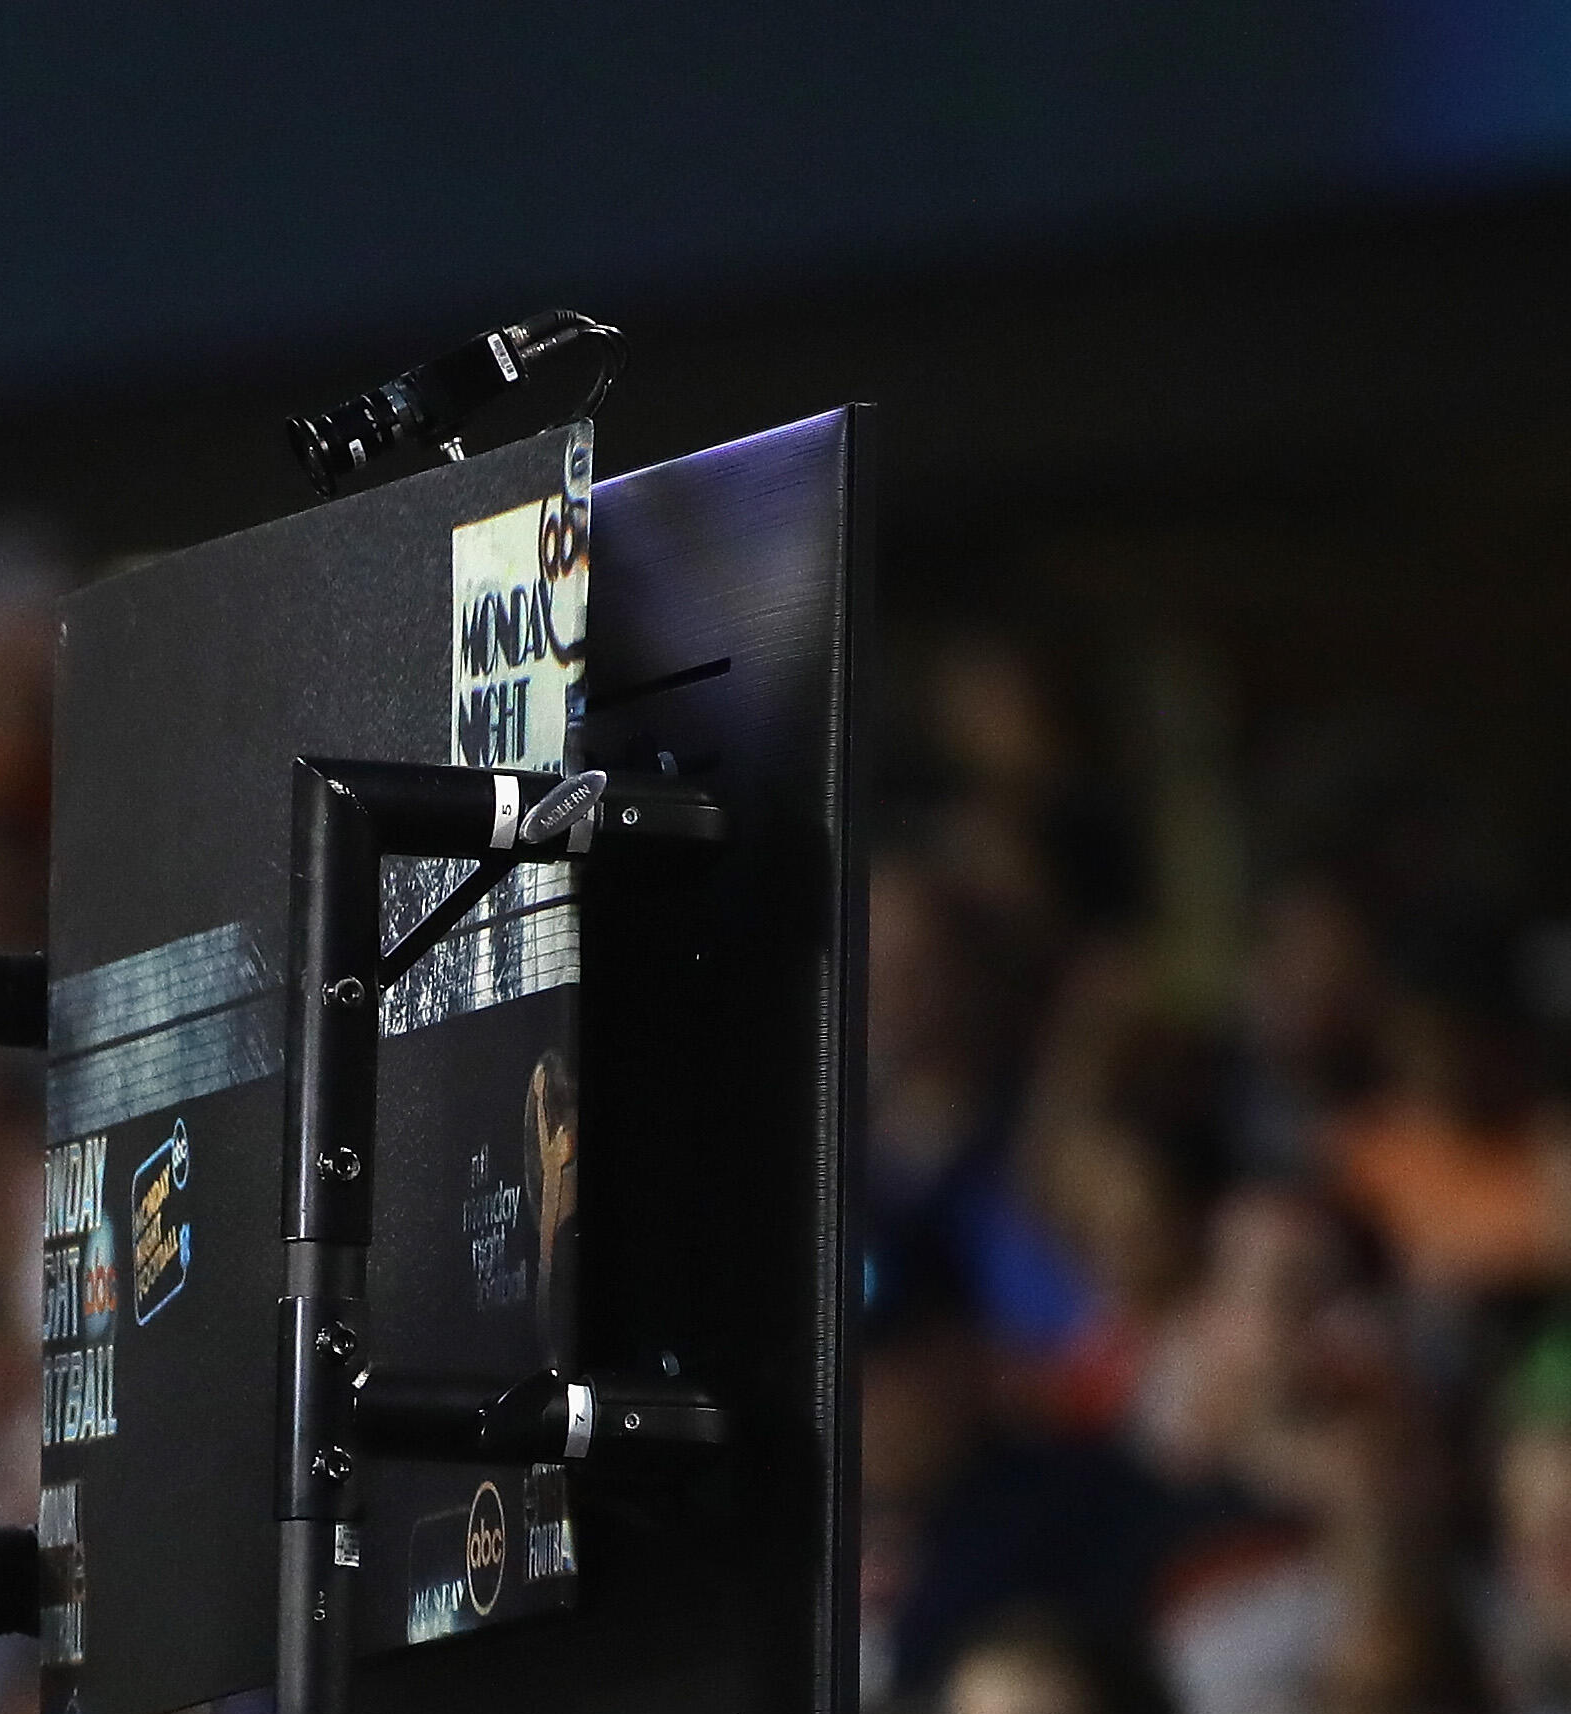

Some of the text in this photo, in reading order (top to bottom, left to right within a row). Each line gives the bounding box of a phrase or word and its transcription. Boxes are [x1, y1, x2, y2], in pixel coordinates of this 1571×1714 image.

[501, 804, 512, 816] 5
[540, 783, 592, 830] MODERN
[43, 1345, 117, 1446] OTBALL
[470, 1517, 503, 1568] abc
